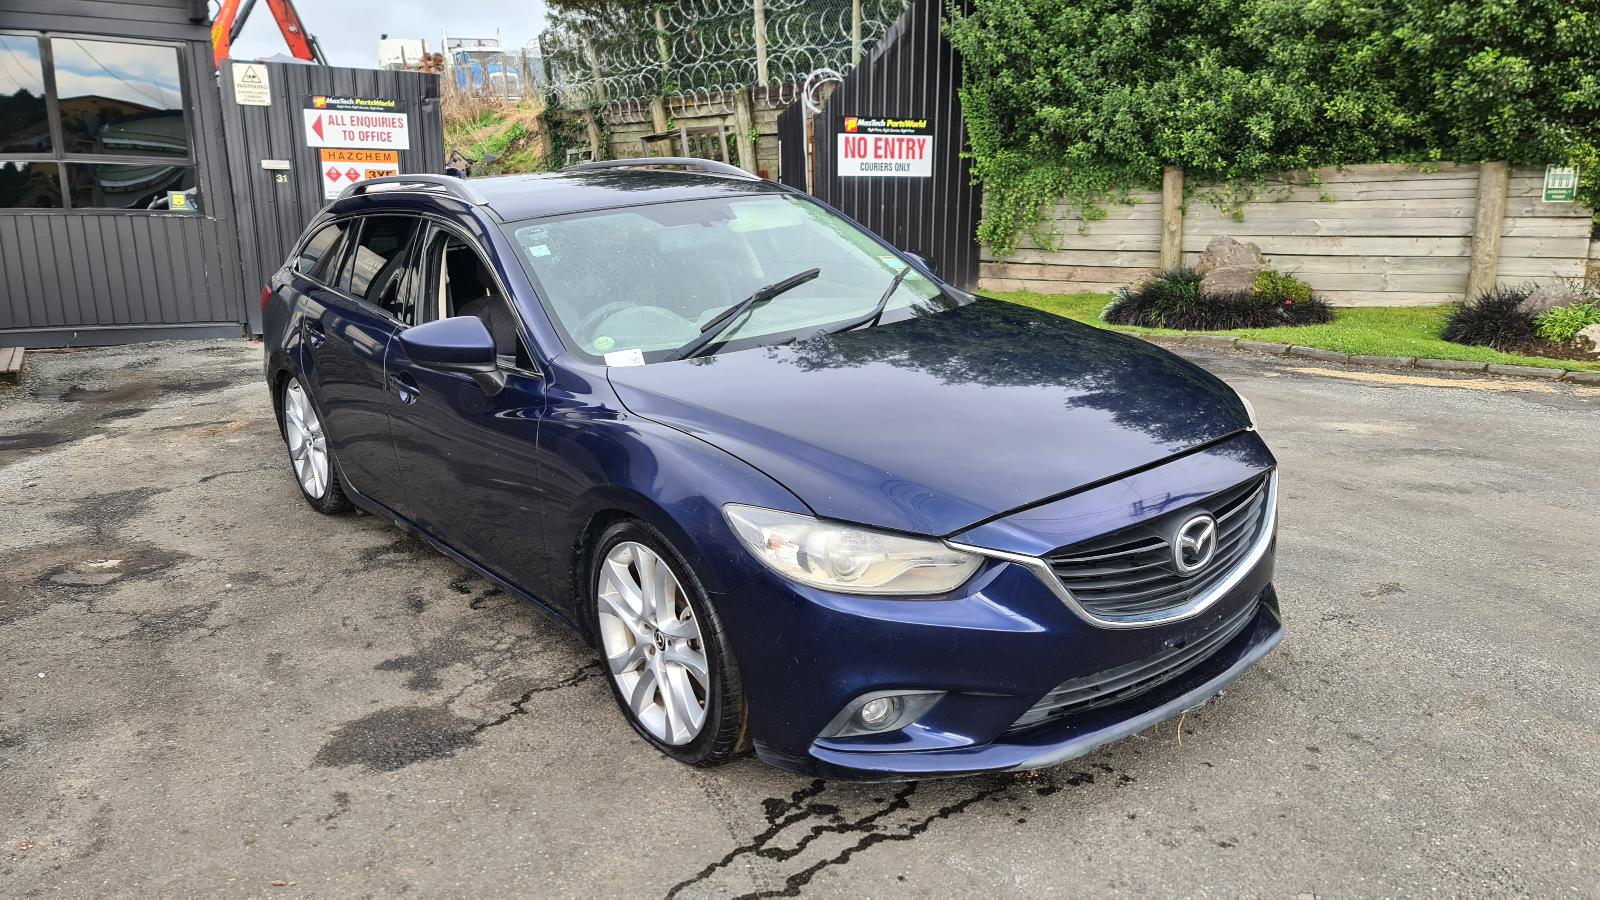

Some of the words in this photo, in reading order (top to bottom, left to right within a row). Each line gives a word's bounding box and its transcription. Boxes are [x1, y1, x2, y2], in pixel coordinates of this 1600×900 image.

[326, 97, 354, 105] MaxTech
[355, 98, 395, 108] PartsWorld
[328, 114, 347, 126] ALL
[350, 115, 404, 129] ENQUIRIES
[857, 118, 886, 127] MaxTech
[887, 119, 927, 128] PartsWorld
[342, 129, 355, 141] TO
[358, 130, 392, 142] OFFICE
[844, 136, 868, 159] NO
[873, 136, 926, 160] ENTRY
[328, 151, 392, 161] HAZCHEM
[860, 162, 893, 172] COURIERS
[894, 162, 911, 172] ONLY
[276, 174, 288, 183] 31
